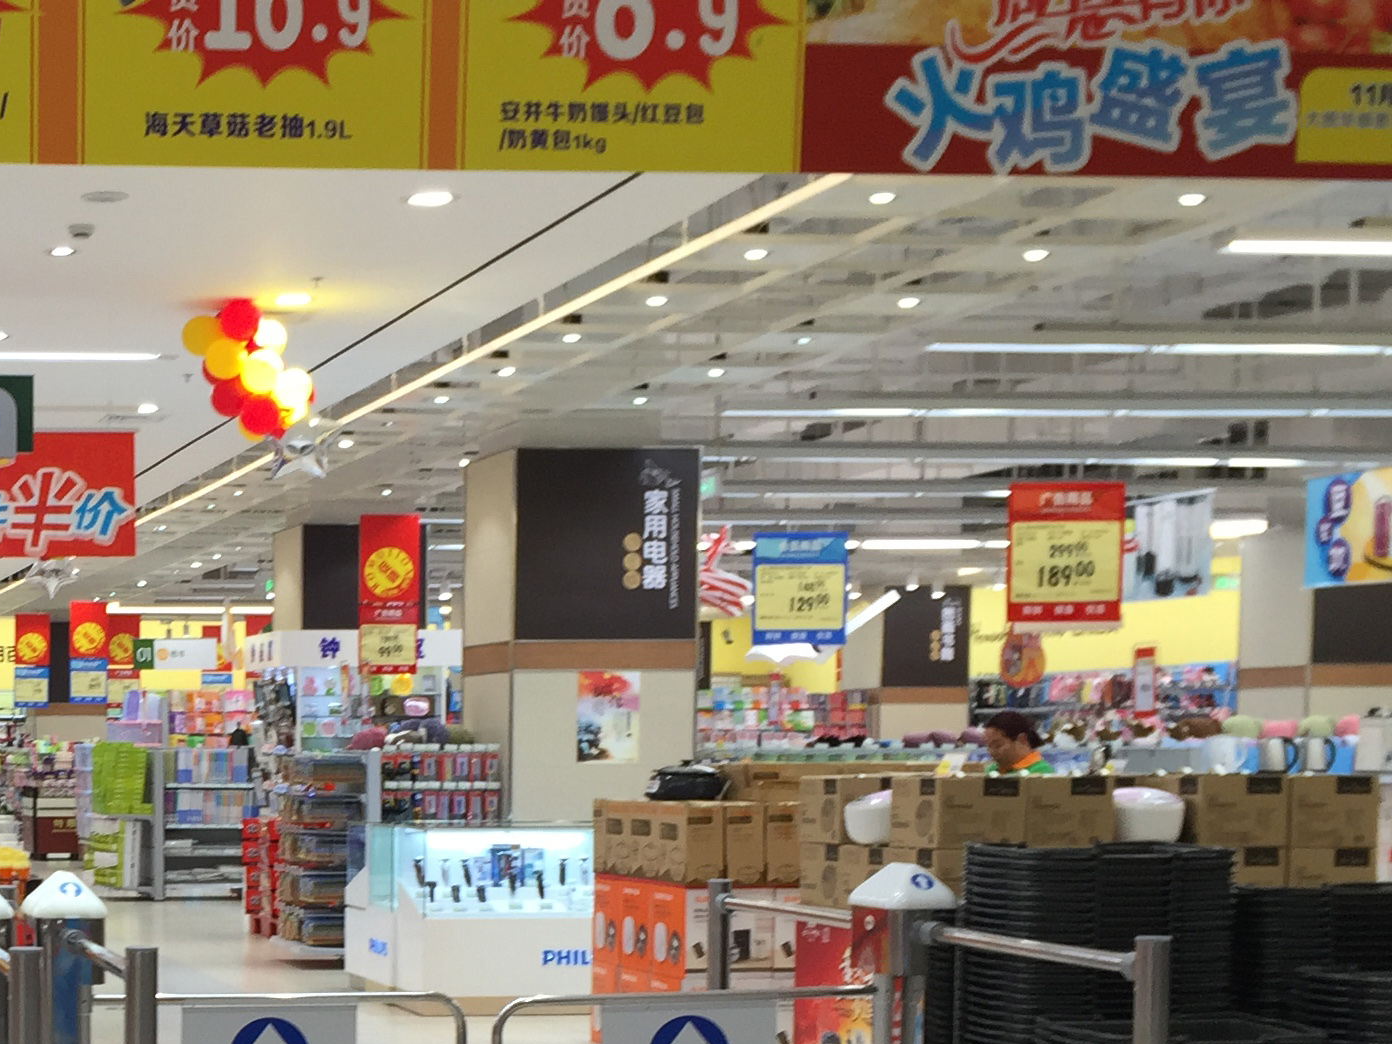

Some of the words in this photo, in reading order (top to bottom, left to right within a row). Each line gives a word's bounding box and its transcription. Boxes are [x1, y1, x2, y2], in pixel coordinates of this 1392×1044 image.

[144, 111, 353, 139] 海天草菇老抽1.9L
[888, 40, 1296, 172] 火鸡盛宴
[642, 488, 670, 590] 家用电器
[542, 949, 591, 966] PHIL
